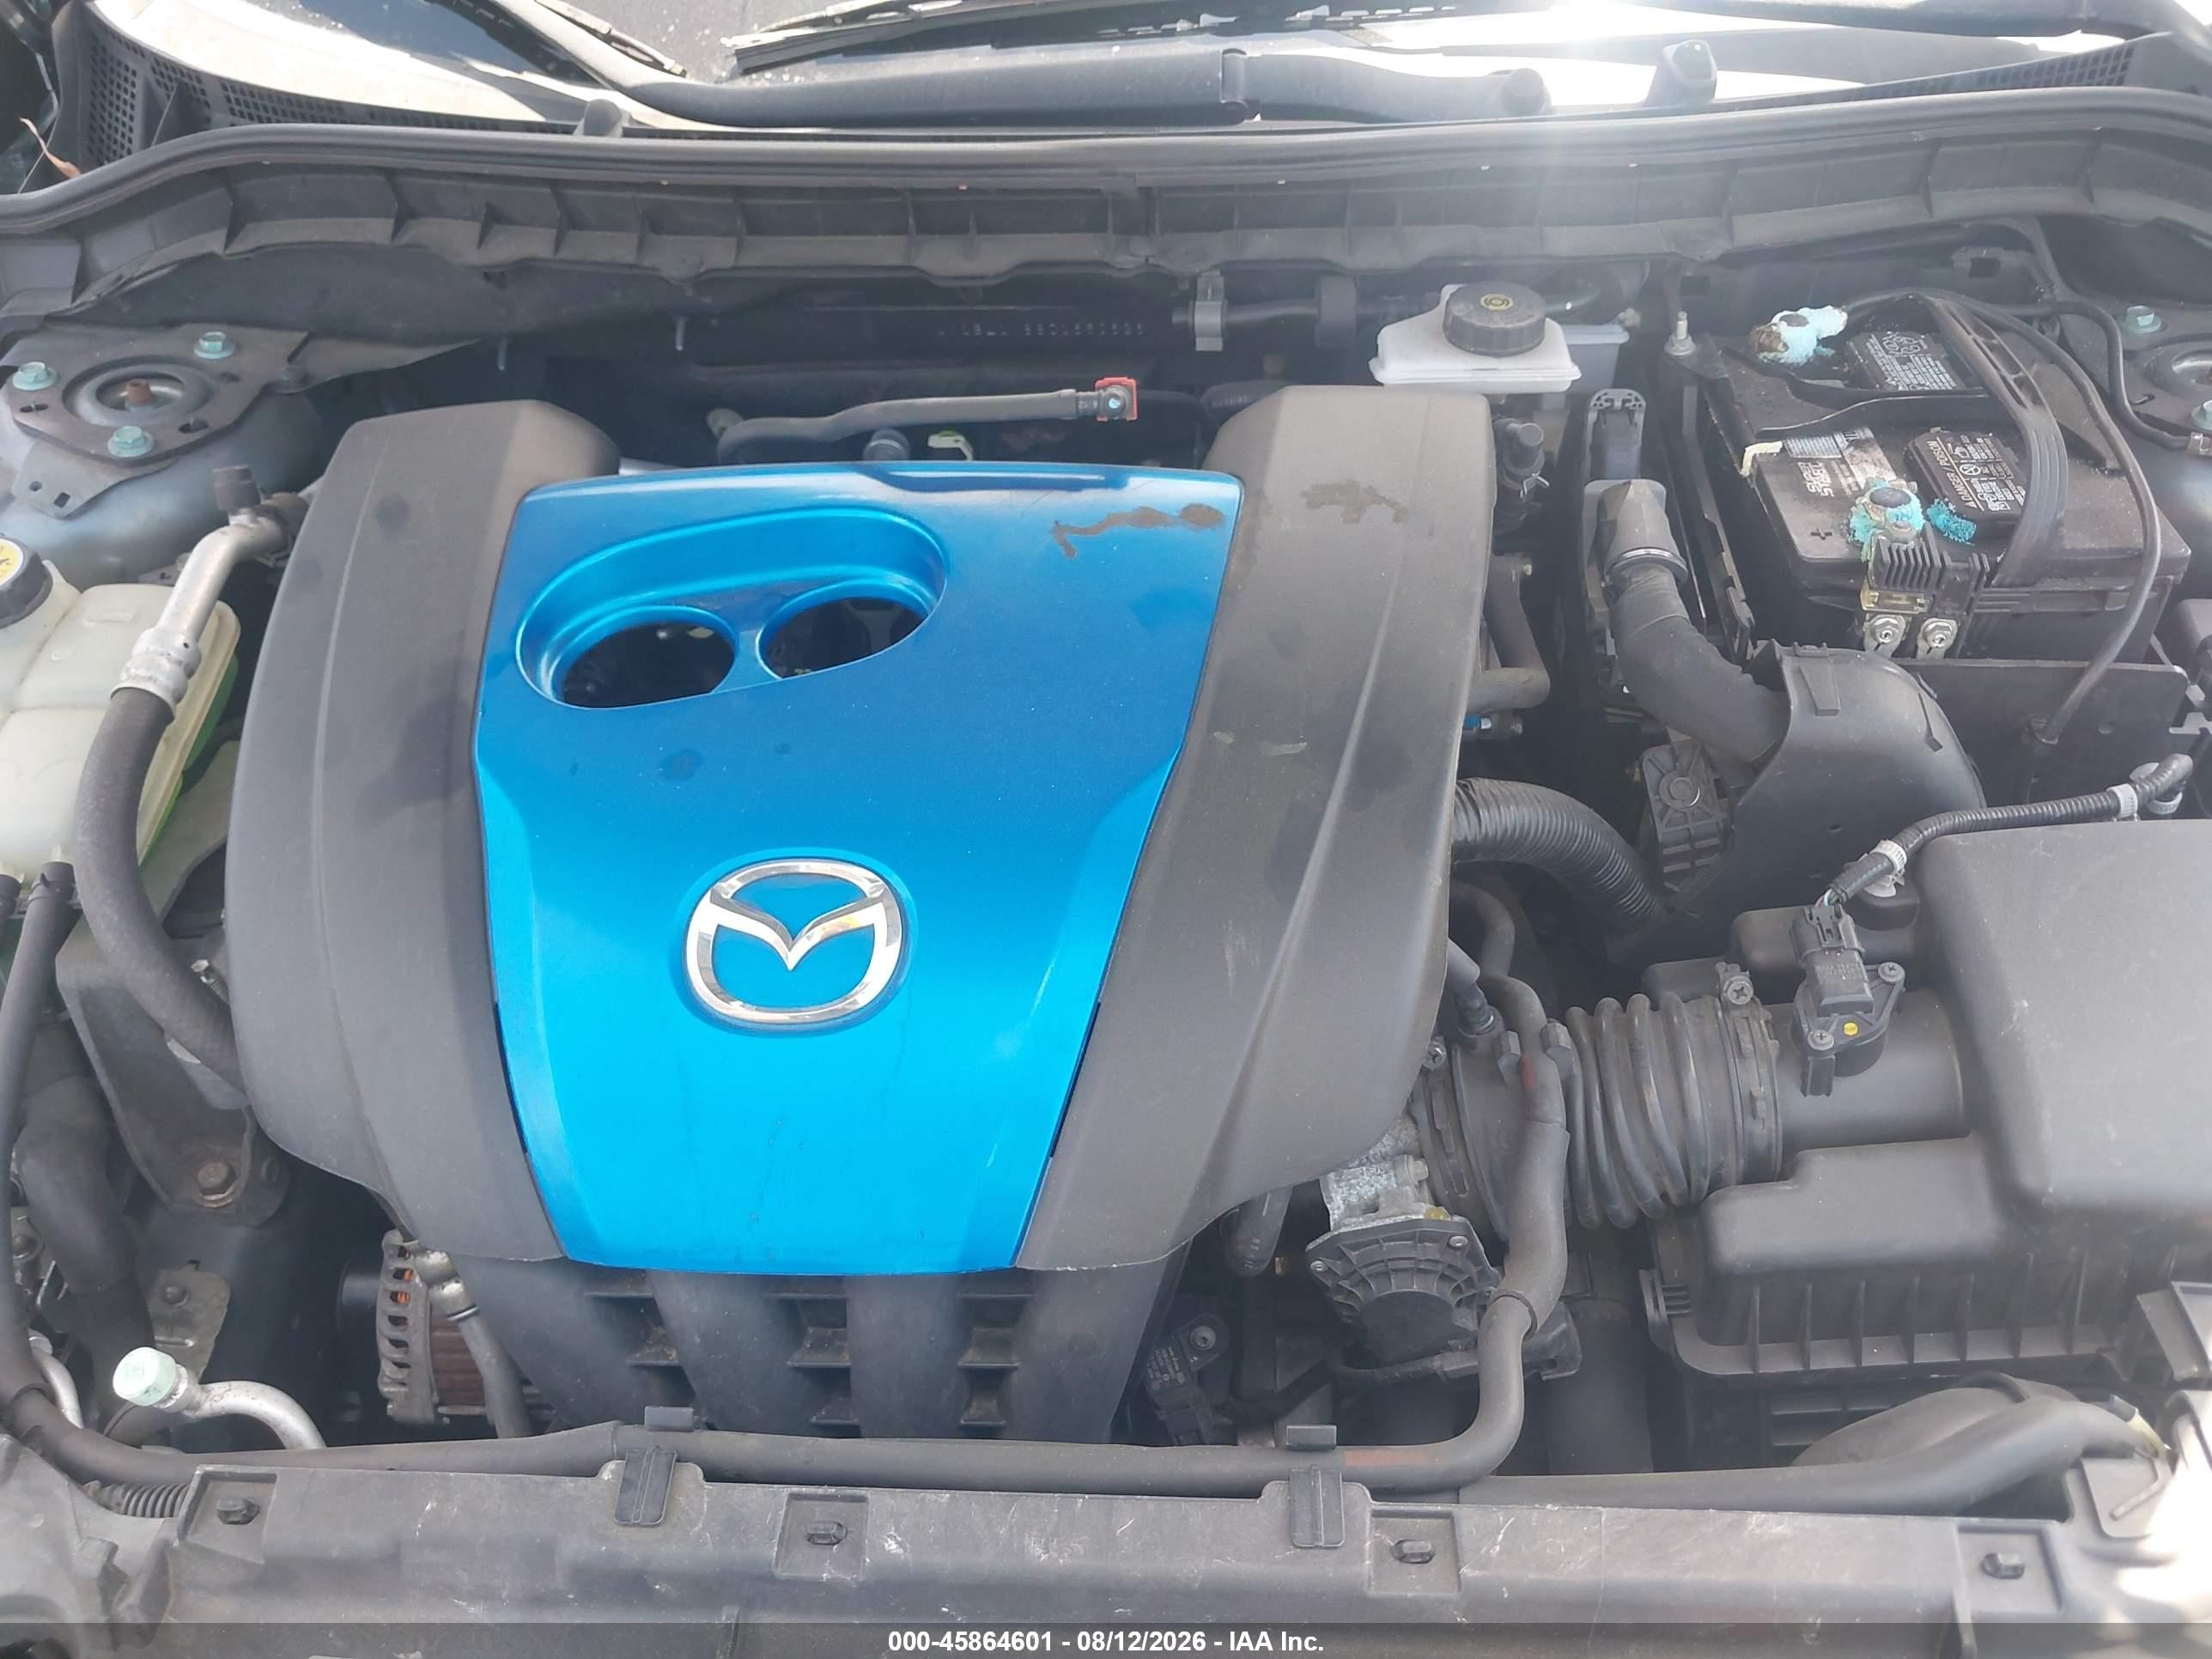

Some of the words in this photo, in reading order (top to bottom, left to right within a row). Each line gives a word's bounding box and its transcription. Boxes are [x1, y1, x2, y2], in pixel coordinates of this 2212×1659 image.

[1926, 441, 1951, 465] POISON
[1797, 462, 1820, 493] SUPER
[1808, 461, 1834, 497] START
[1947, 472, 1974, 501] DANGER
